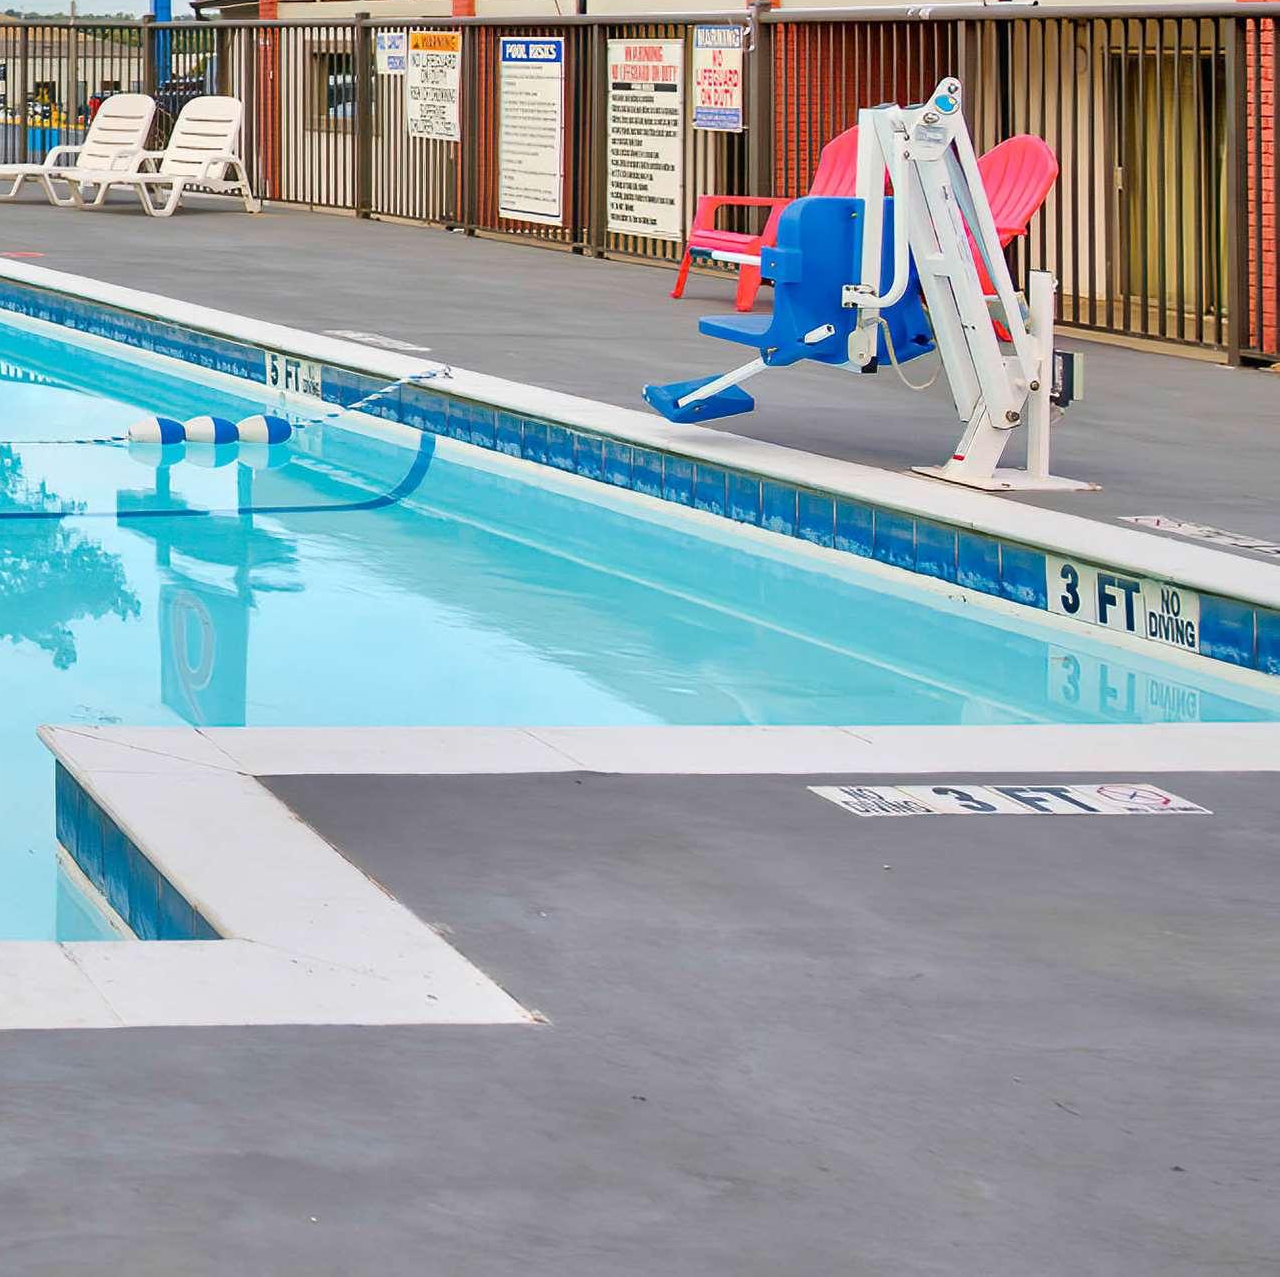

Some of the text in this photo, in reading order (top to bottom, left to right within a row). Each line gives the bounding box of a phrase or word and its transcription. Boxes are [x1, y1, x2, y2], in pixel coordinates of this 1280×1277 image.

[505, 43, 527, 59] POOL
[625, 46, 663, 61] WARNING
[712, 49, 724, 67] NO
[697, 69, 739, 88] LIFEGUARD
[700, 88, 734, 106] ON DUTY
[270, 354, 279, 387] 5
[285, 358, 301, 392] FT
[1060, 564, 1141, 632] 3 FT
[1160, 587, 1181, 618] NO
[1148, 611, 1196, 649] DIVING
[932, 786, 1103, 813] 3 FT
